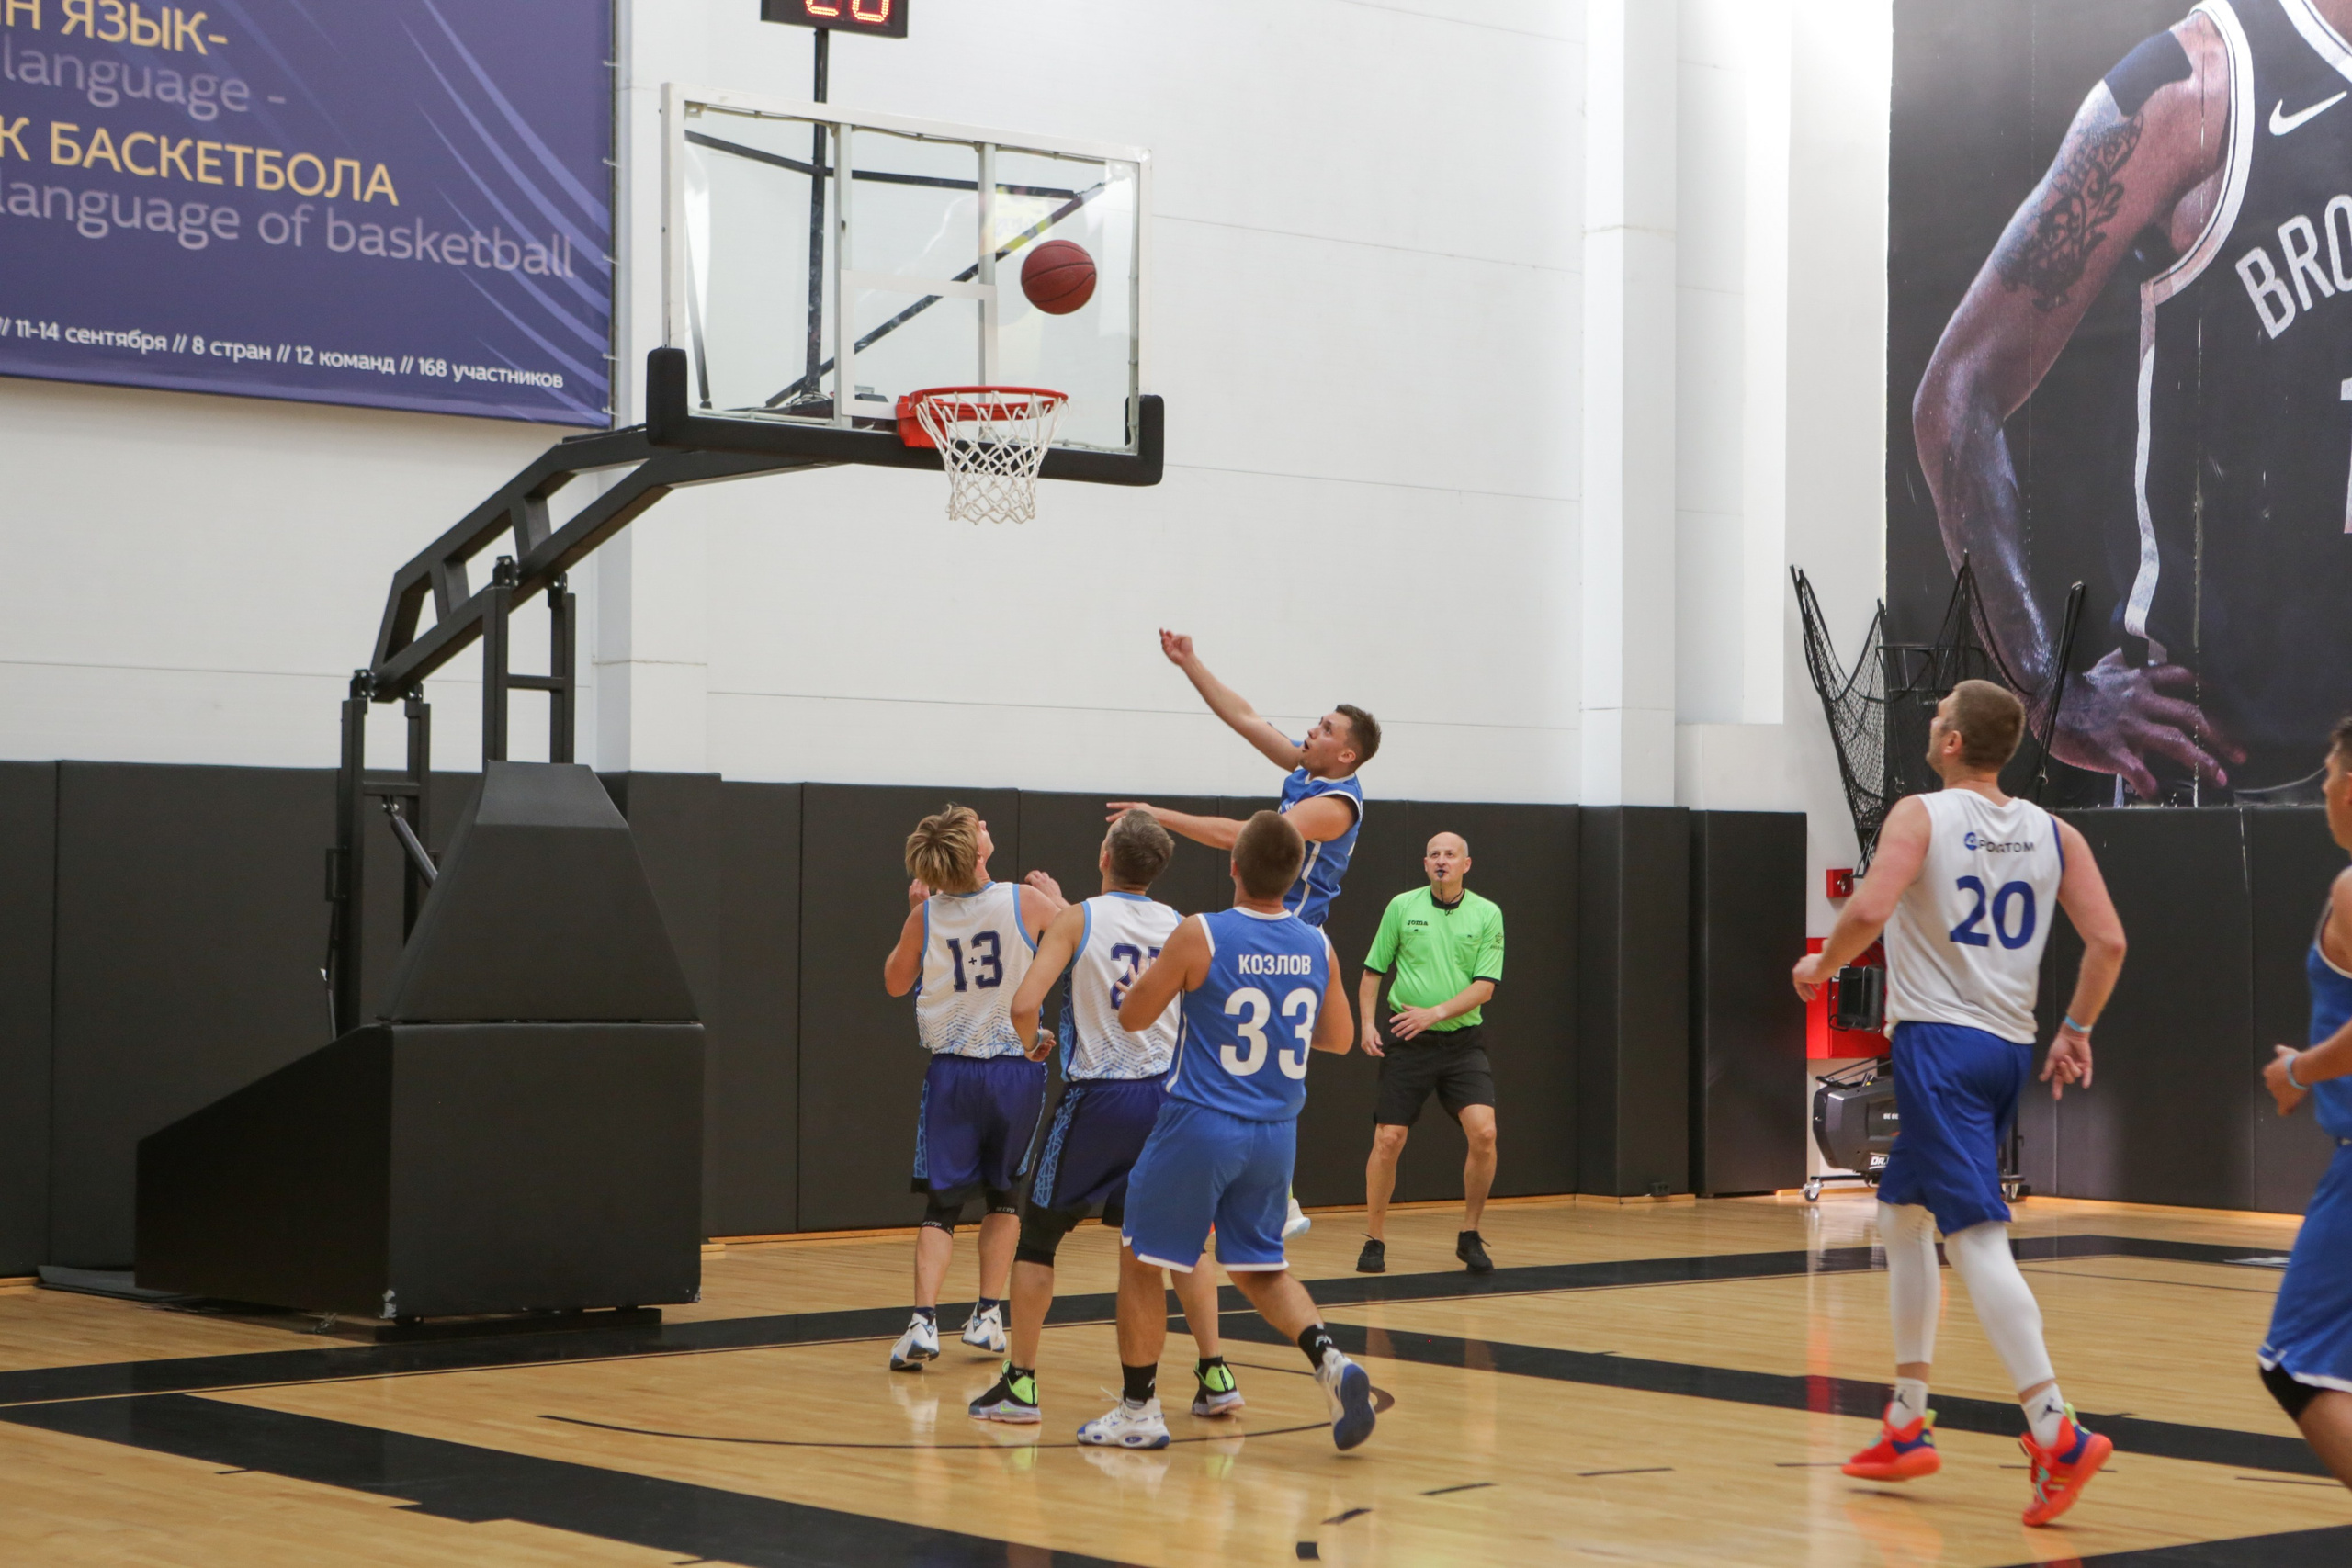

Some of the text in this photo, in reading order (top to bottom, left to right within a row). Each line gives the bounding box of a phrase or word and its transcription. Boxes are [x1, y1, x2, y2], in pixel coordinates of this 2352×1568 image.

[61, 0, 228, 55] ЯЗЫК-
[4, 33, 250, 121] language
[51, 121, 399, 206] БАСКЕТБОЛА
[0, 182, 574, 278] anguage of basketball
[2235, 194, 2352, 340] BRO
[15, 319, 60, 341] 11-14
[65, 327, 167, 355] сентября
[192, 336, 205, 355] 8
[210, 339, 271, 363] стран
[295, 345, 313, 366] 12
[319, 351, 396, 375] команд
[418, 357, 447, 377] 168
[452, 364, 563, 389] участников
[1950, 875, 2036, 950] 20
[946, 930, 1003, 992] 13
[1110, 942, 1162, 1010] 2
[1238, 954, 1312, 975] КОЗЛОВ
[1219, 987, 1317, 1080] 33
